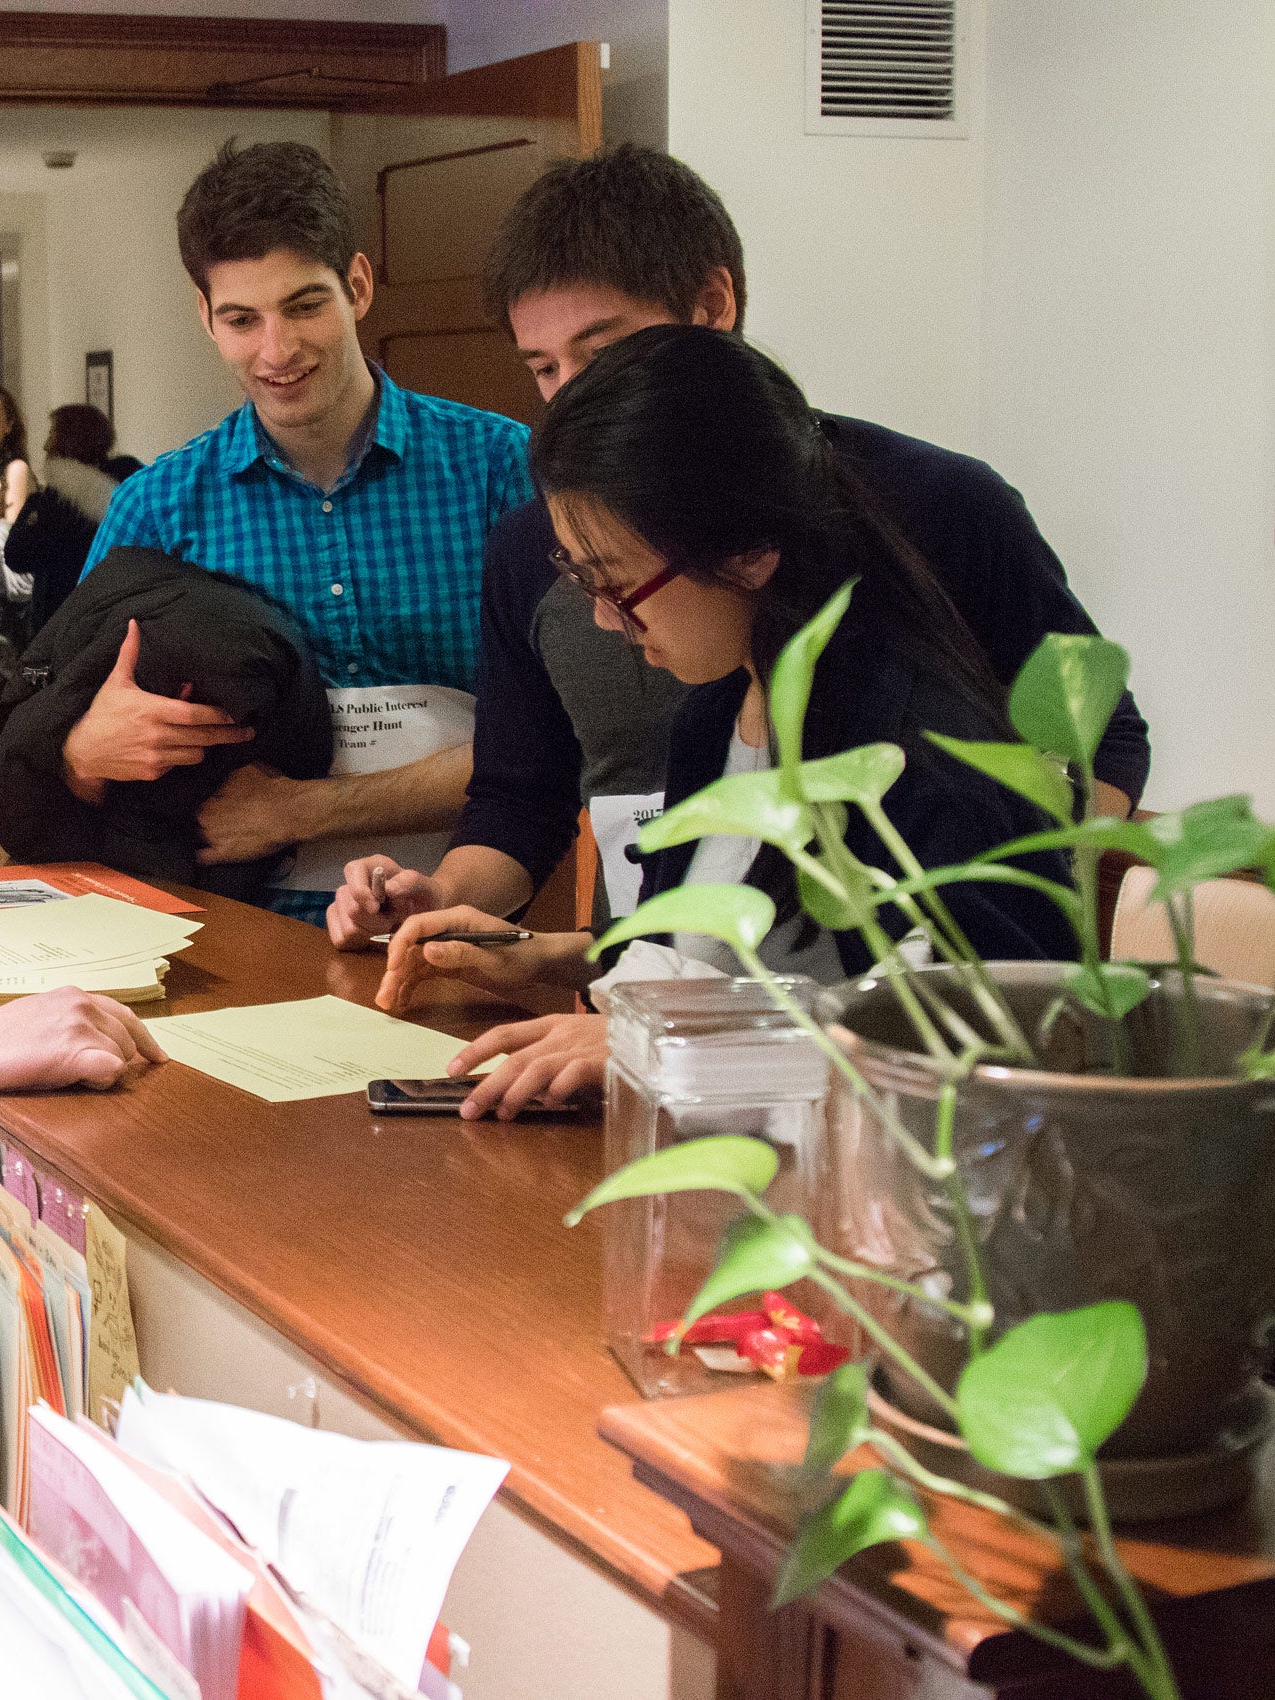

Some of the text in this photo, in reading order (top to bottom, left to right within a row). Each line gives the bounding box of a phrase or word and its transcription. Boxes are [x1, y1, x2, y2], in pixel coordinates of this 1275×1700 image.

[346, 703, 382, 714] Public
[385, 700, 428, 712] Interest
[373, 720, 403, 731] Hunt
[339, 739, 367, 749] Team
